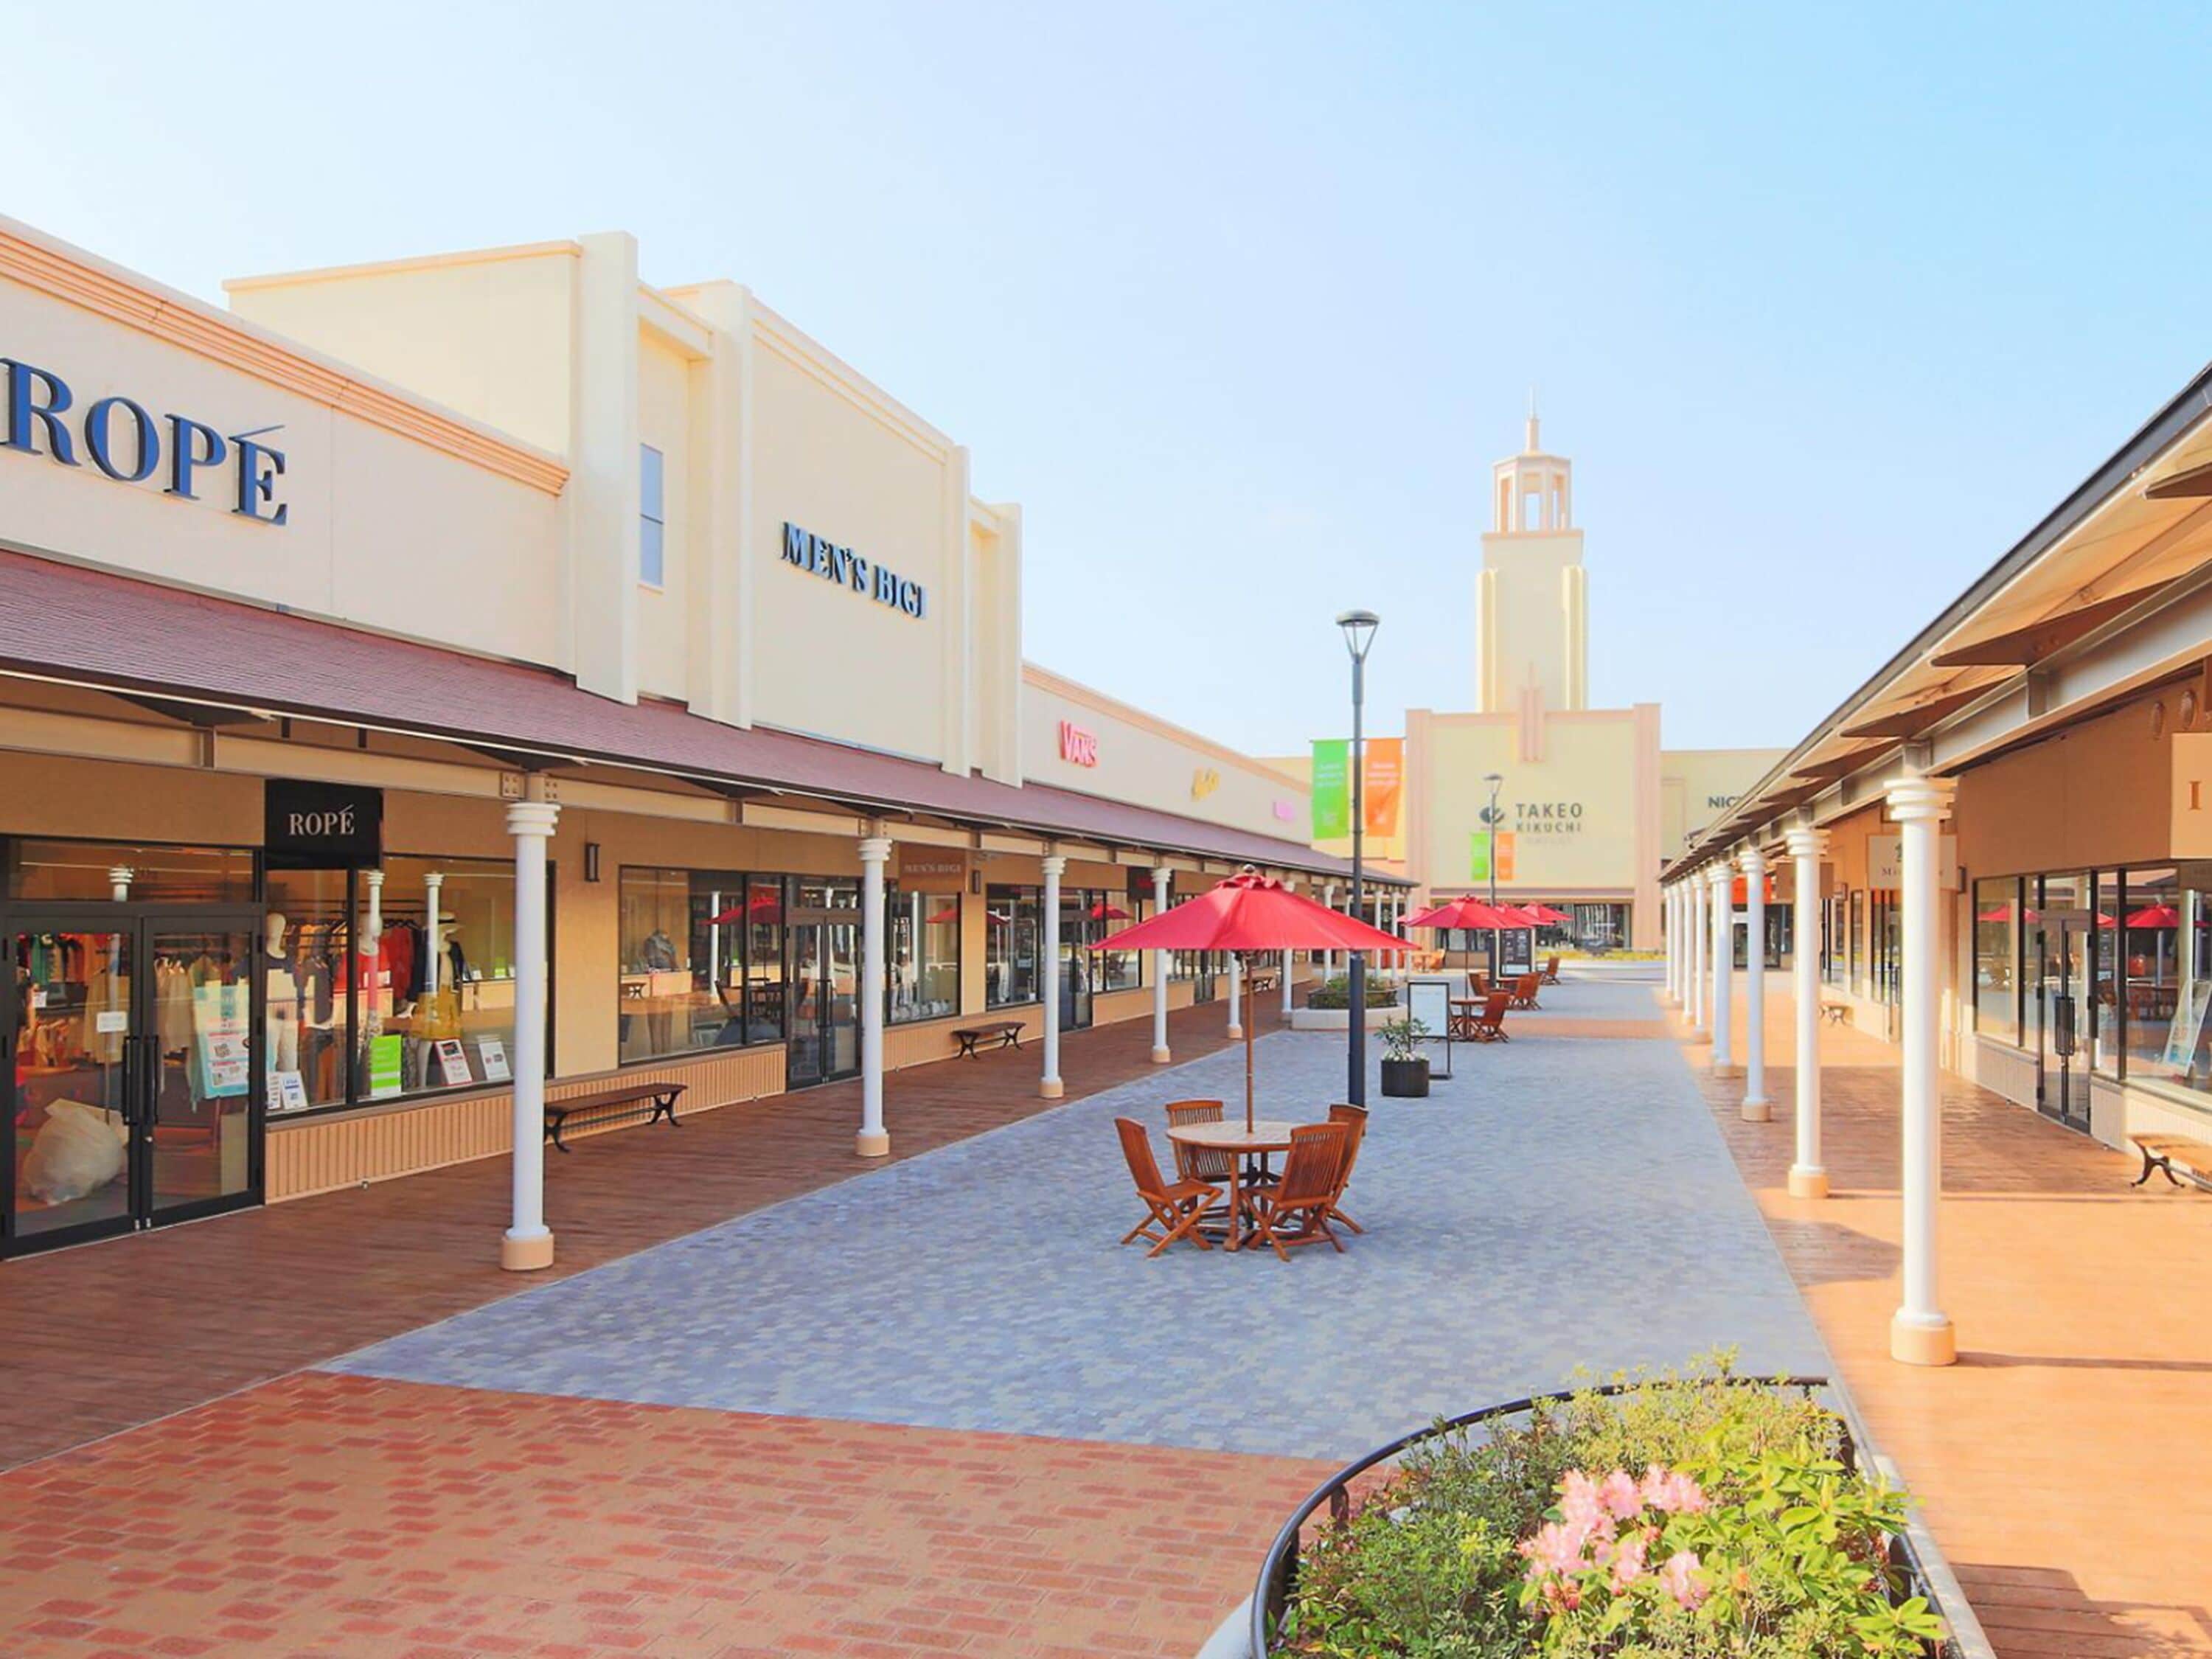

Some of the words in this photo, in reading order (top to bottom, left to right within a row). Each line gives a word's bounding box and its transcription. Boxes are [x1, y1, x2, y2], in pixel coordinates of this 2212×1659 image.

[0, 358, 288, 526] ROPÉ
[782, 521, 869, 592] MEN'S
[1060, 720, 1097, 768] VANS
[289, 804, 355, 835] ROPÉ
[1516, 803, 1582, 818] TAKEO
[1516, 822, 1582, 832] KIKUCHI
